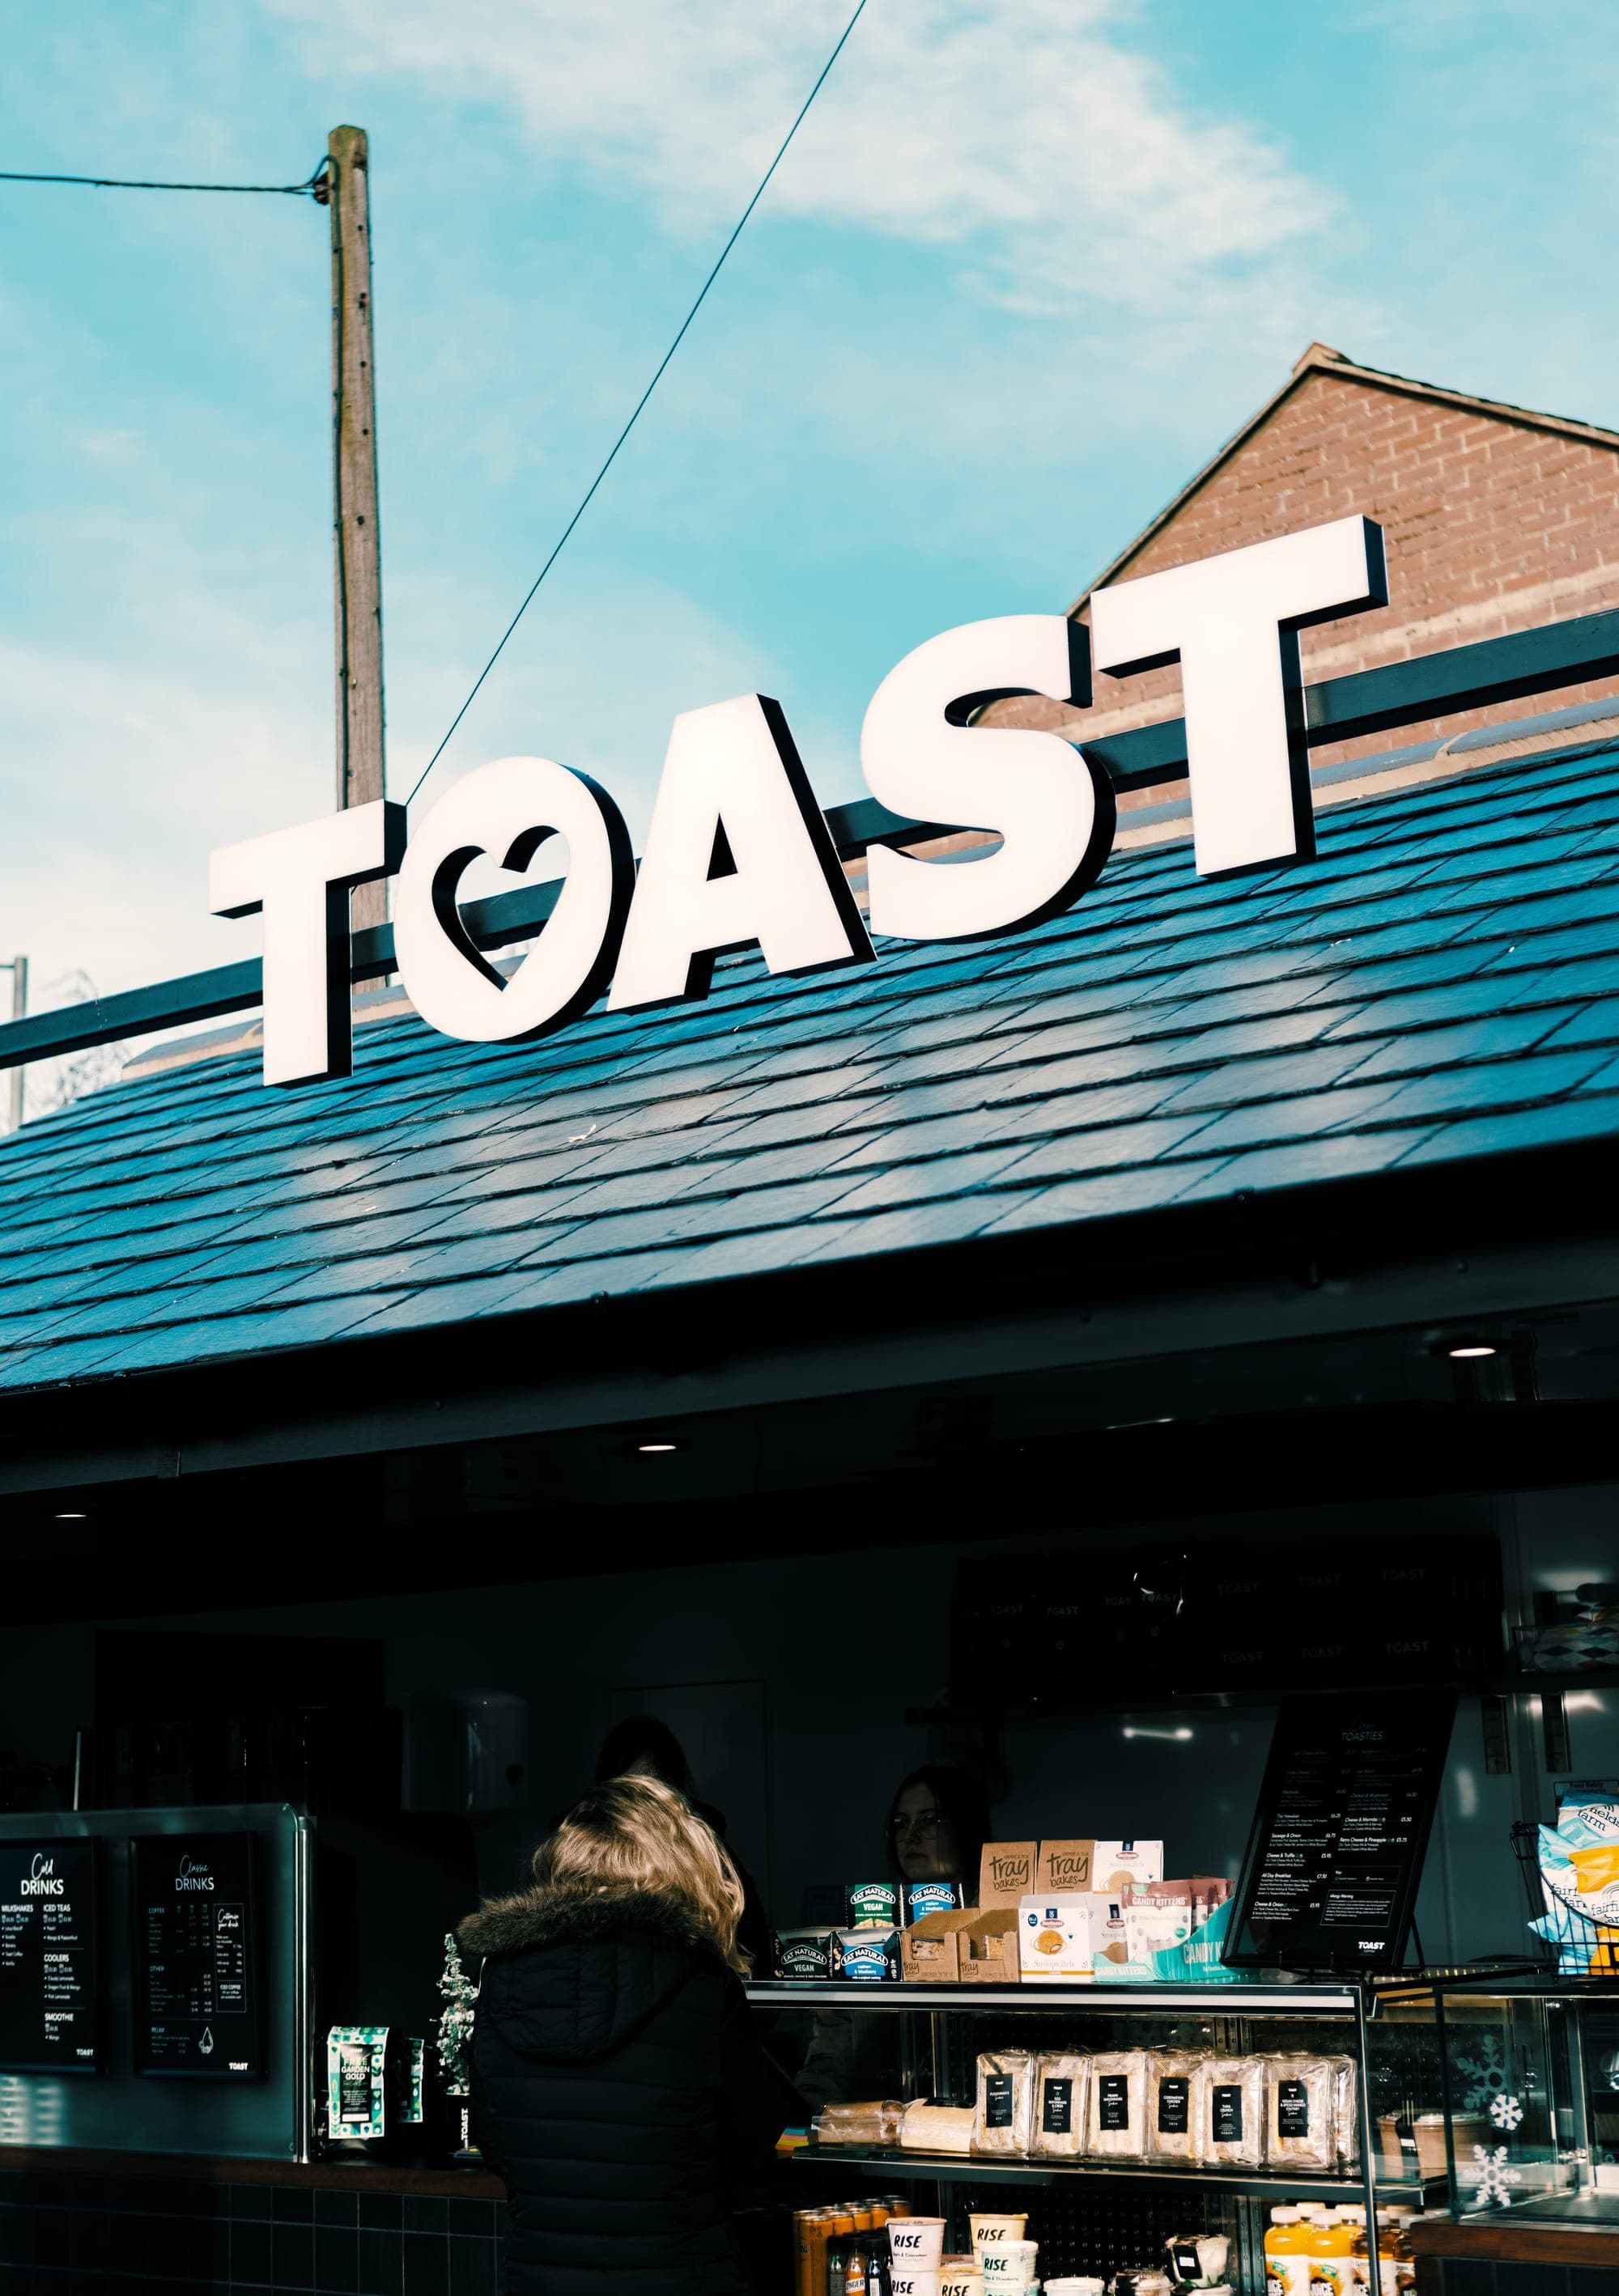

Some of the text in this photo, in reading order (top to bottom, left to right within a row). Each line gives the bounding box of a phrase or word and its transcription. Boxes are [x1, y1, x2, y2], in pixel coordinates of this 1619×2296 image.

[209, 515, 1387, 1086] TOAST
[989, 1856, 1029, 1885] tray
[1047, 1853, 1089, 1882] tray
[20, 1878, 65, 1896] DRINKS
[175, 1876, 215, 1891] DRINKS
[993, 1878, 1020, 1891] bakes
[1050, 1875, 1077, 1887] bakes
[853, 1886, 894, 1902] EAT NATURAL
[911, 1887, 953, 1901] EAT NATURAL
[1, 1903, 34, 1912] MILKSHAKES
[43, 1903, 71, 1912] ICED TEAS
[863, 1903, 883, 1911] VEGAN
[1132, 1897, 1186, 1906] CANDY KITTENS
[1358, 1941, 1386, 1950] TOAST
[44, 1954, 70, 1963] COOLERS
[783, 1948, 825, 1963] EAT NATURAL
[843, 1949, 886, 1964] EAT NATURAL
[1183, 1942, 1214, 1964] CANDY
[903, 1961, 920, 1975] tray
[959, 1961, 979, 1975] tray
[45, 2012, 74, 2022] SMOOTHIE
[76, 2048, 95, 2056] TOAST
[228, 2061, 249, 2071] TOAST
[341, 2065, 370, 2073] GARDEN
[345, 2073, 366, 2081] GOLD
[460, 2107, 469, 2141] TOAST
[894, 2234, 923, 2248] RISE
[977, 2228, 1006, 2241] RISE
[984, 2258, 1009, 2271] RISE
[892, 2281, 915, 2294] RISE
[941, 2285, 970, 2296] RISE
